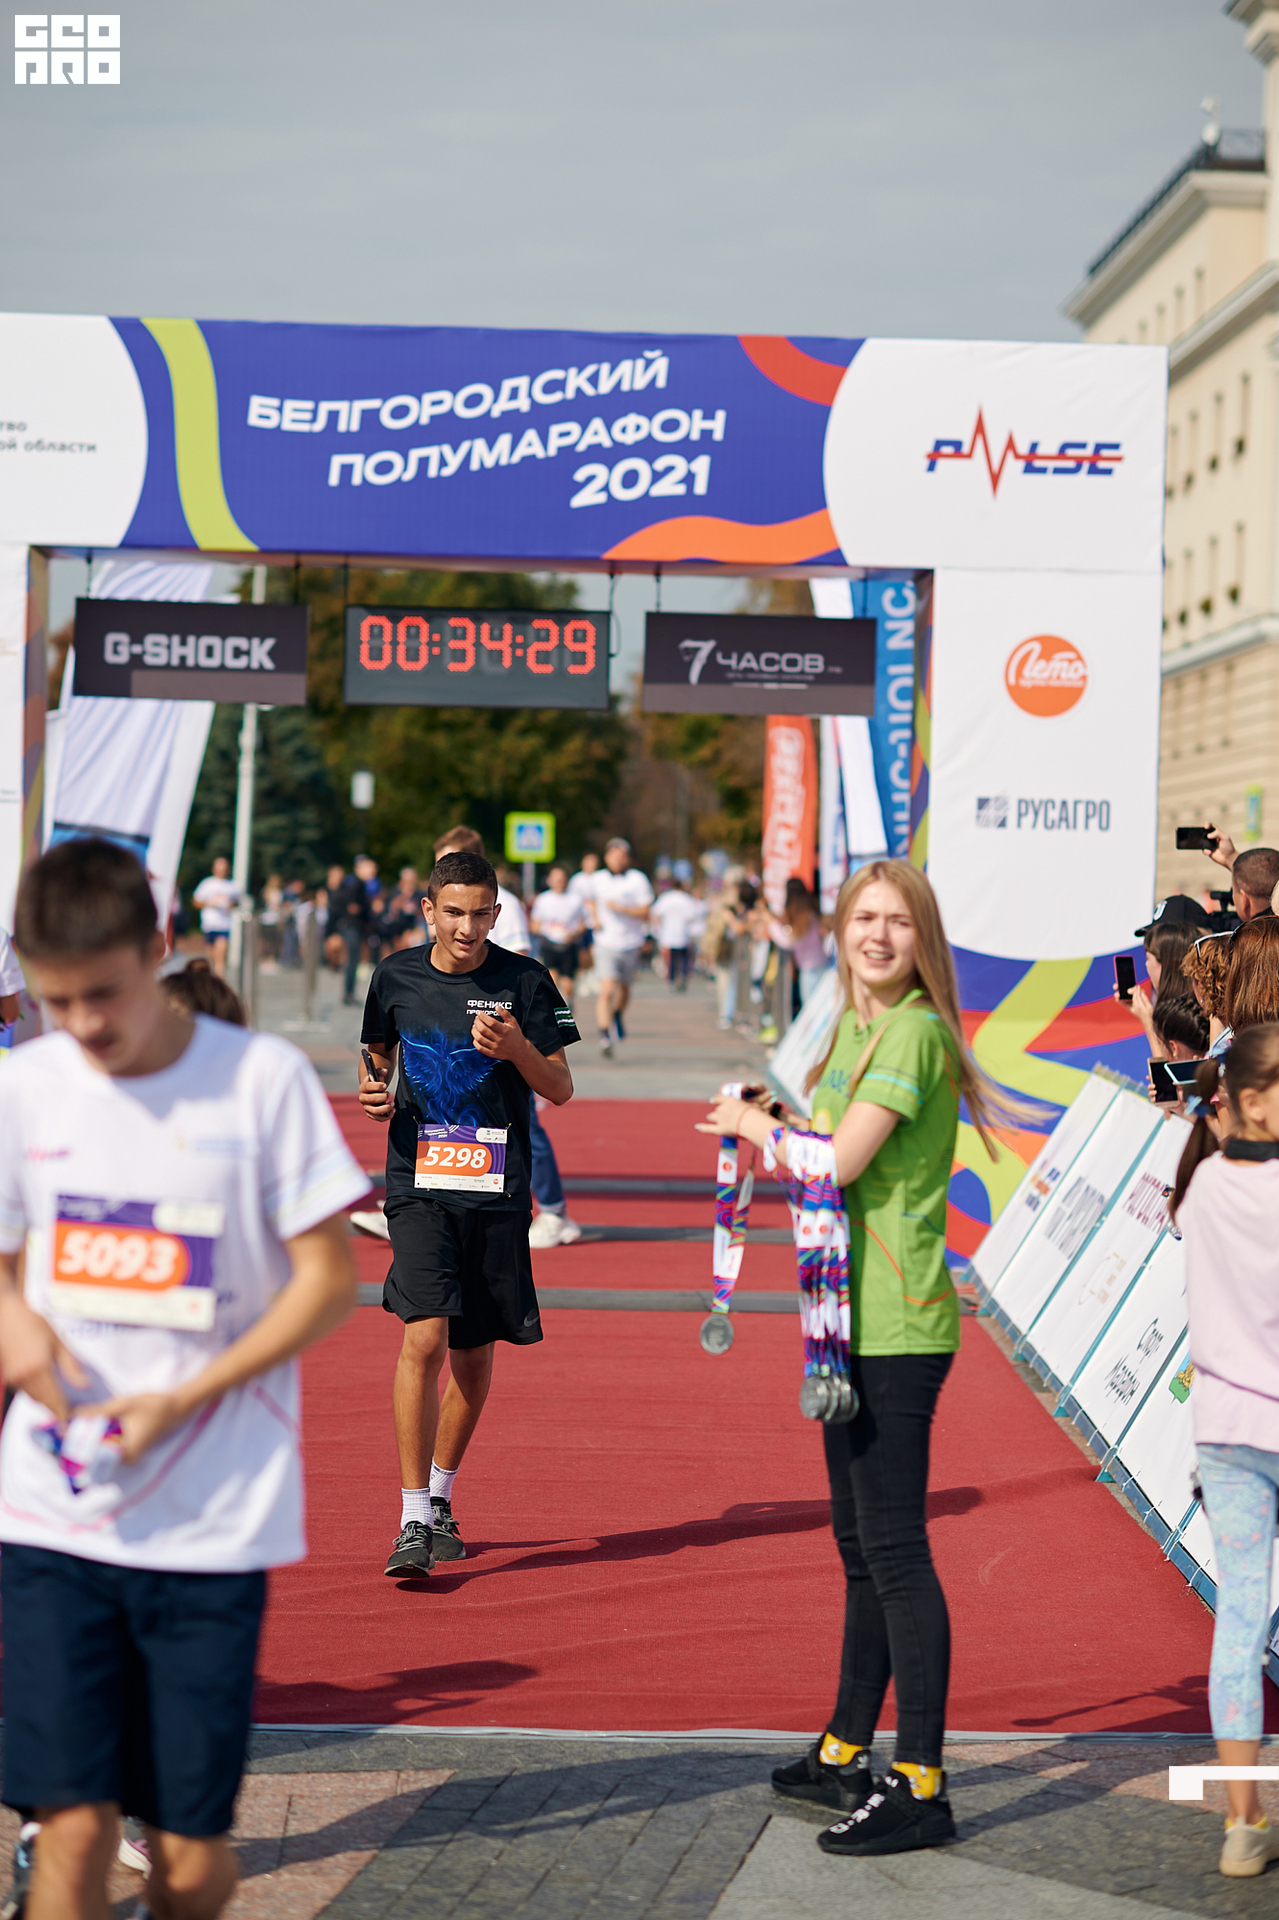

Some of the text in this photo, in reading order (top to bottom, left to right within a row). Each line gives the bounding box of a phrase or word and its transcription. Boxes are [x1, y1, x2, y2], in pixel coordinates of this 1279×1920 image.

[246, 349, 669, 433] БЕЛГОРОДСКИЙ
[24, 438, 97, 453] области
[328, 408, 727, 487] ПОЛУМАРАФОН
[569, 453, 711, 509] 2021
[104, 631, 276, 670] G-SHOCK
[359, 615, 597, 675] 00:34:29
[679, 639, 825, 686] 7 ЧАСОВ
[1007, 640, 1088, 686] Лето
[1016, 798, 1111, 831] РУСАГРО
[467, 999, 513, 1010] ФЕНИКС
[423, 1146, 487, 1169] 5298
[57, 1229, 180, 1283] 5093
